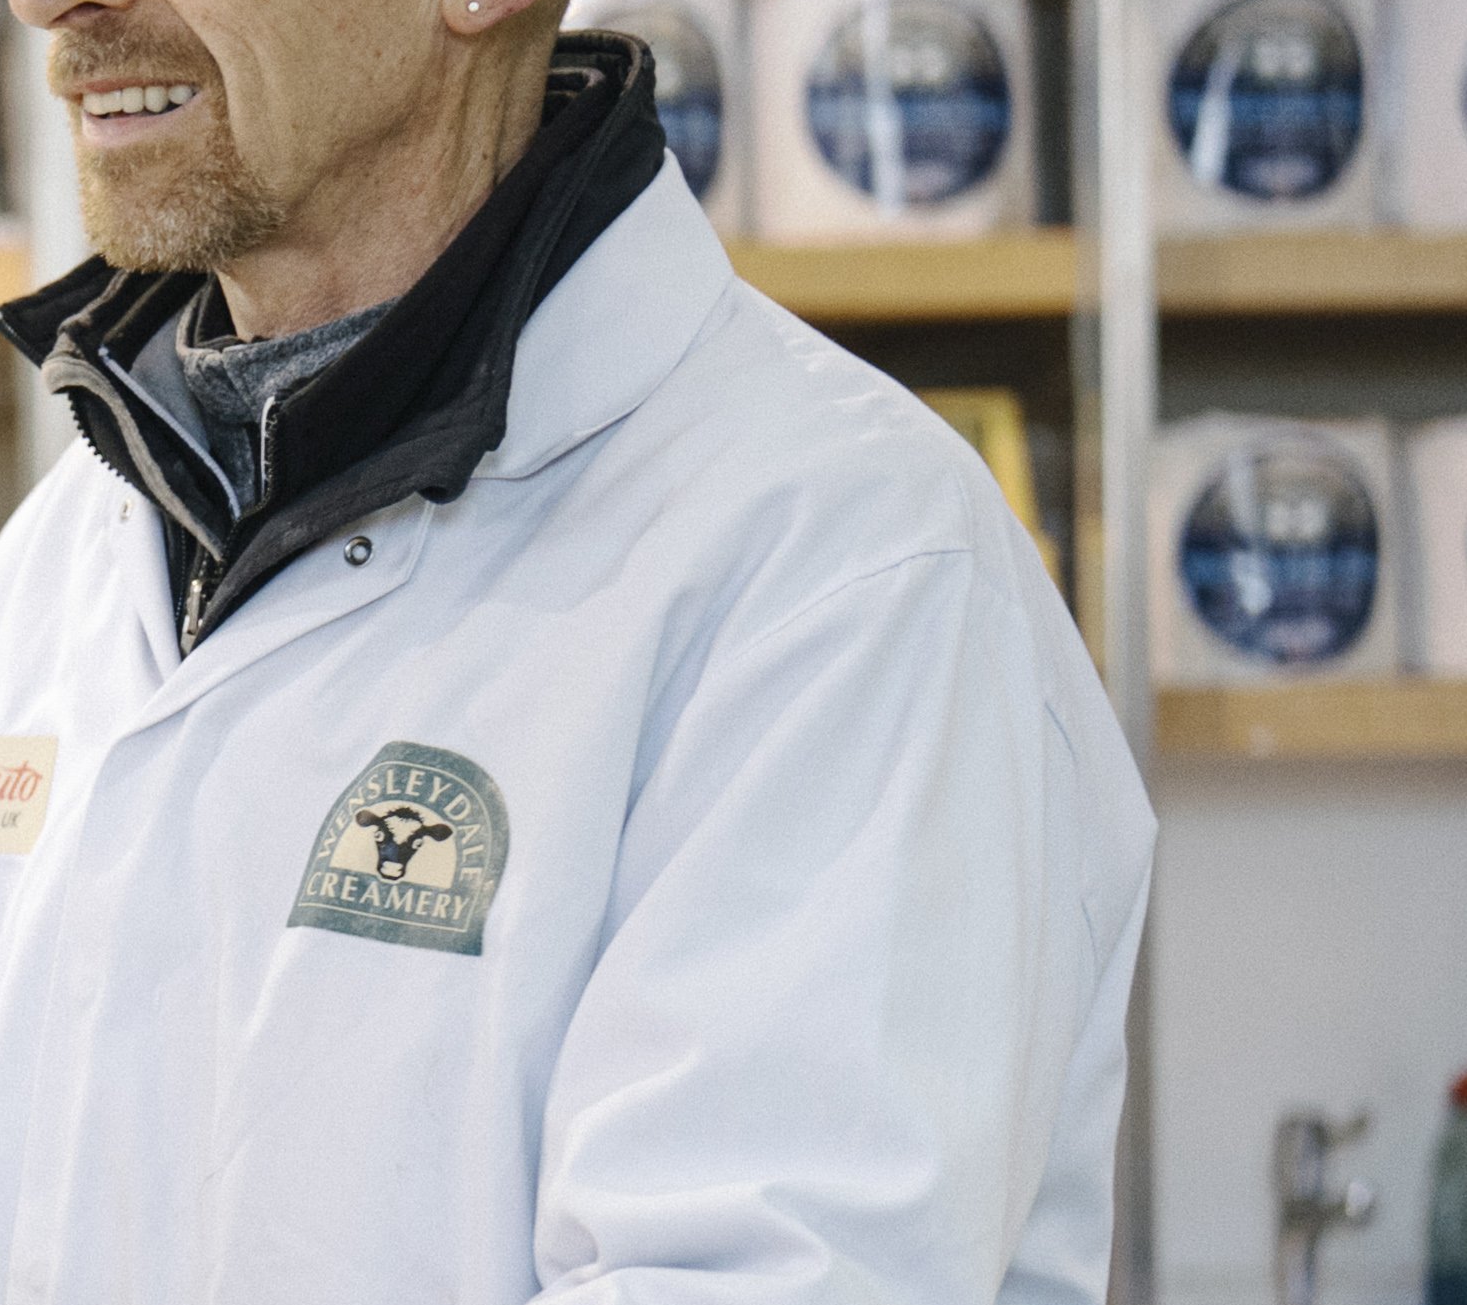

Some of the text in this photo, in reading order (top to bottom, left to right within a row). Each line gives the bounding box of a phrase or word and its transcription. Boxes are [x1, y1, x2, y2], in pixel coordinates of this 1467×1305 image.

[0, 809, 22, 829] UK
[317, 767, 485, 881] WENSLEYDALE
[306, 870, 471, 921] CREAMERY
